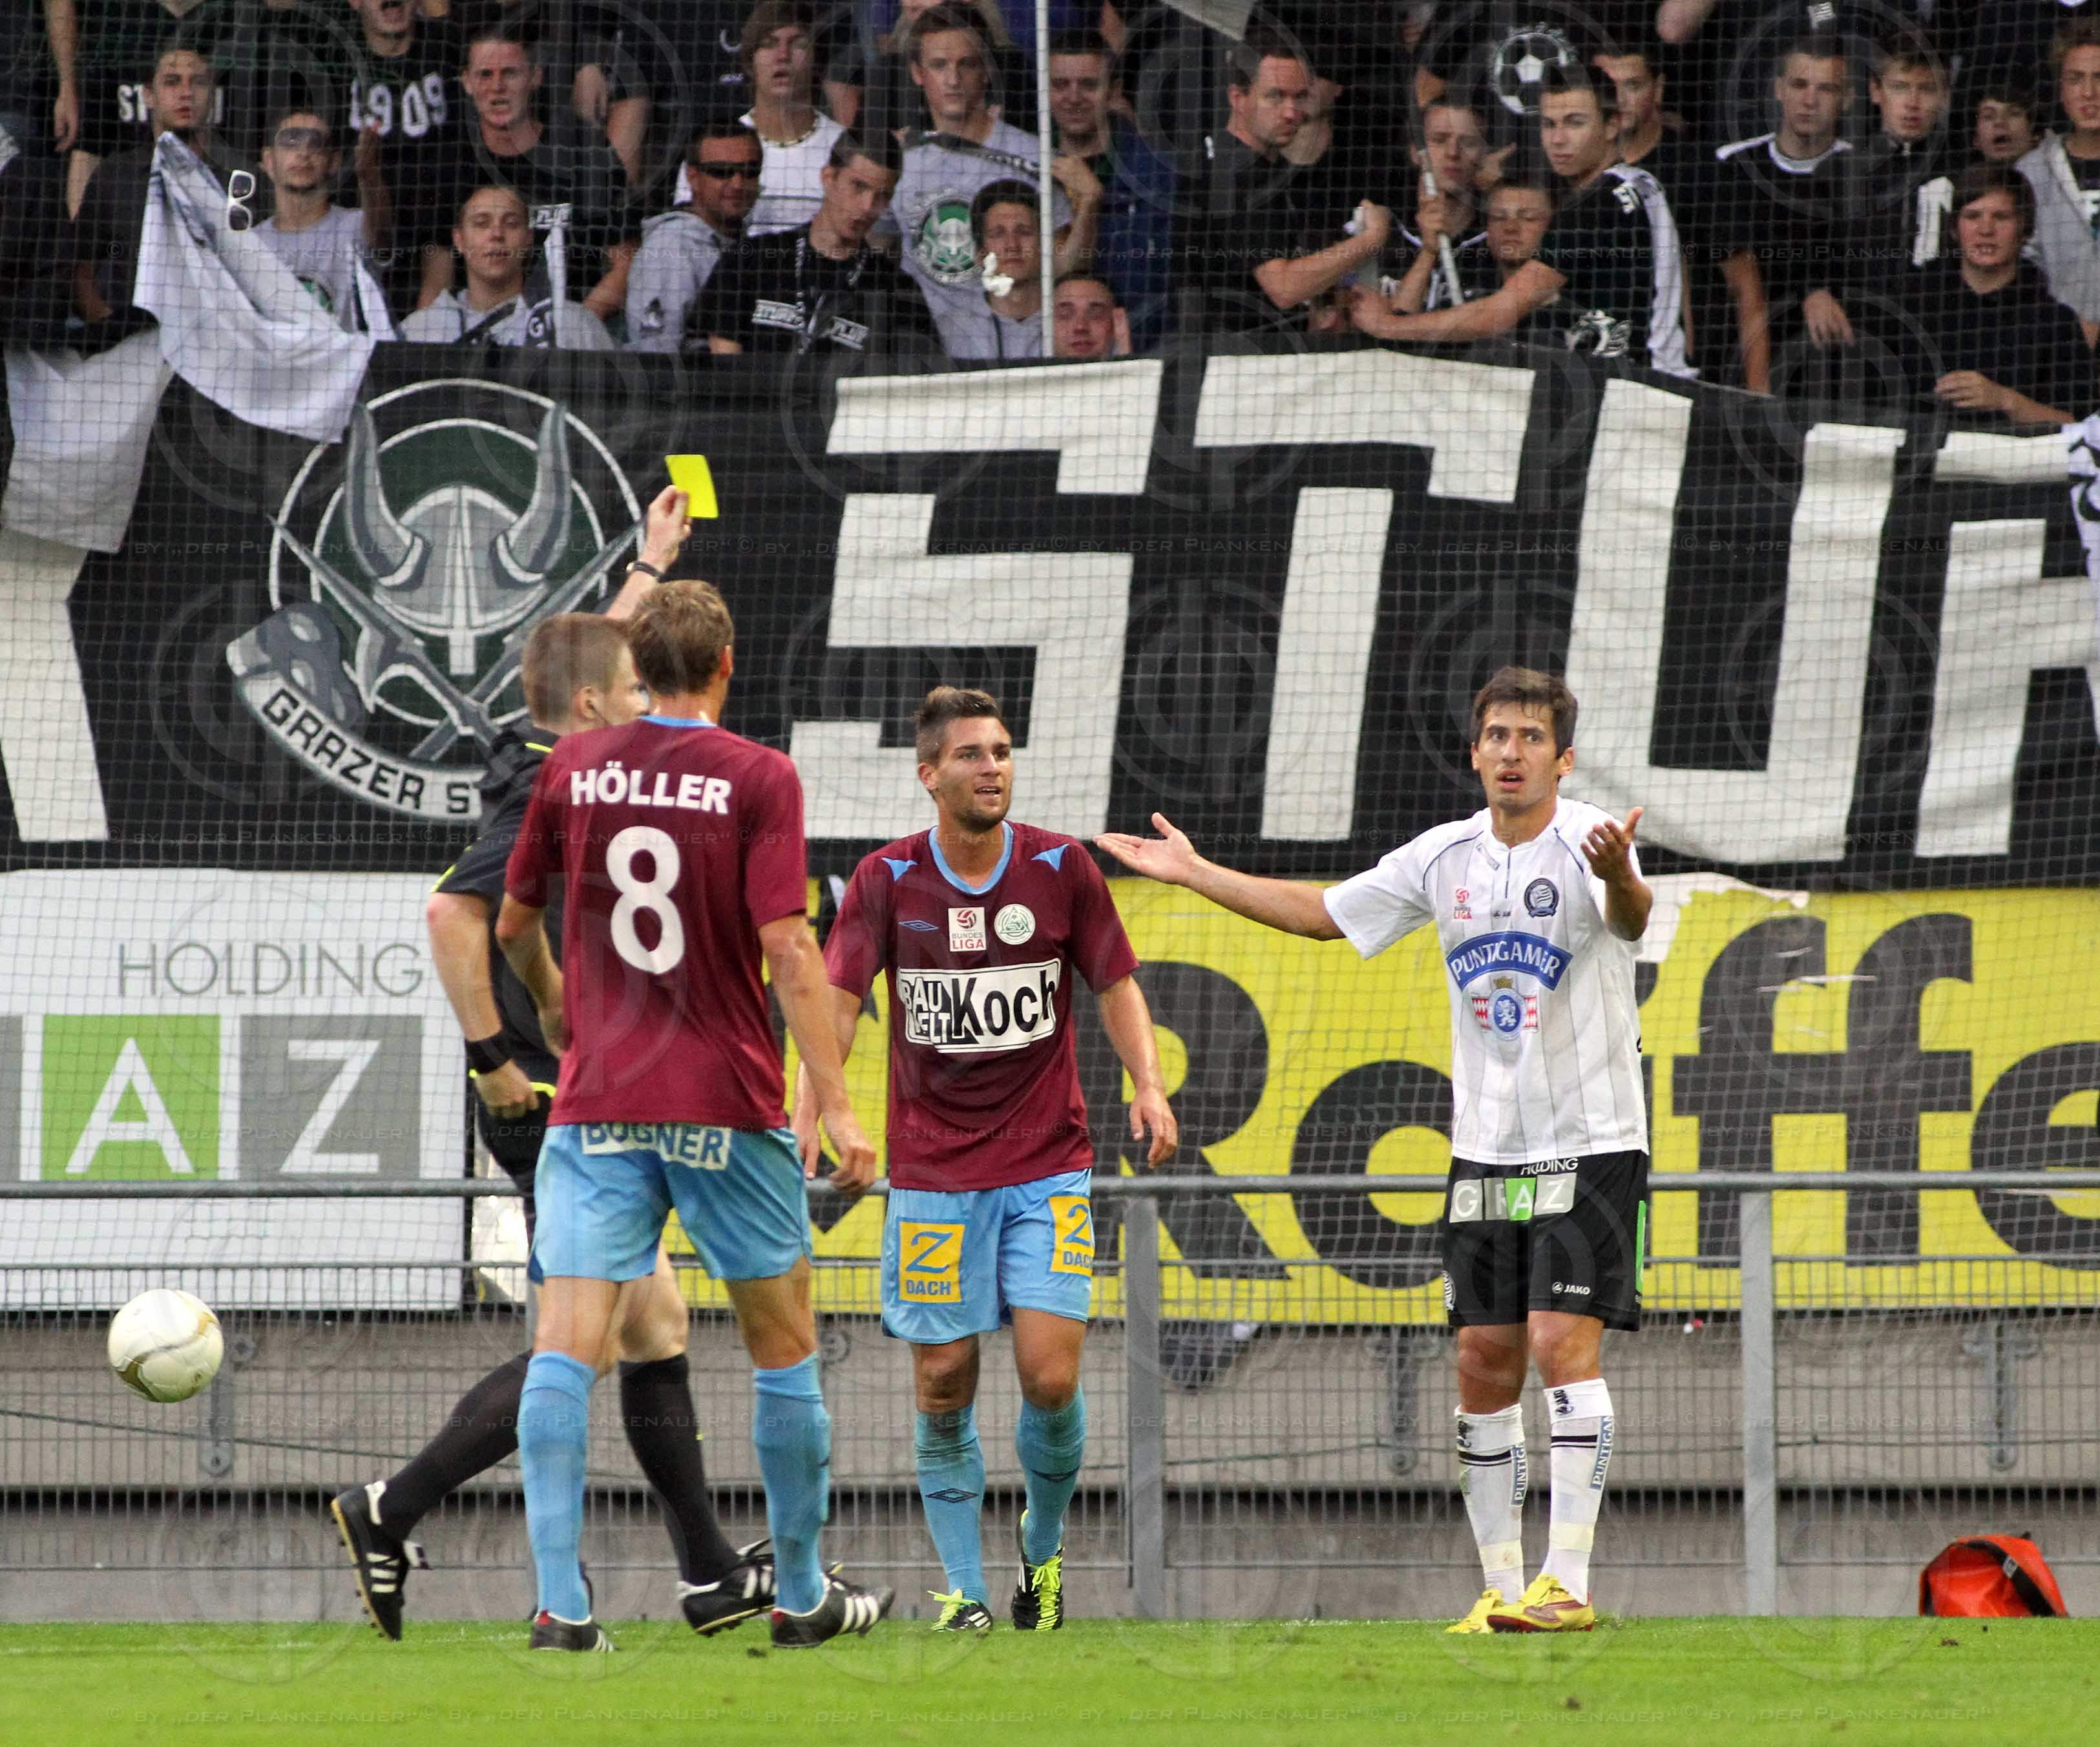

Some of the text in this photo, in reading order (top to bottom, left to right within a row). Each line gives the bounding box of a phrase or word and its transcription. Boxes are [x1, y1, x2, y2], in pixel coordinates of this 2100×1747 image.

[350, 72, 447, 137] 1909
[262, 688, 425, 810] GRAZER
[571, 760, 732, 815] HÖLLER
[605, 825, 686, 975] 8
[118, 943, 424, 998] HOLDING
[952, 938, 985, 950] LIGA
[902, 969, 1056, 1037] BAU Koch
[906, 1279, 952, 1295] DACH
[1062, 1250, 1093, 1269] DAC
[1564, 1284, 1591, 1295] JAKO
[1513, 1443, 1526, 1502] PUNTIG
